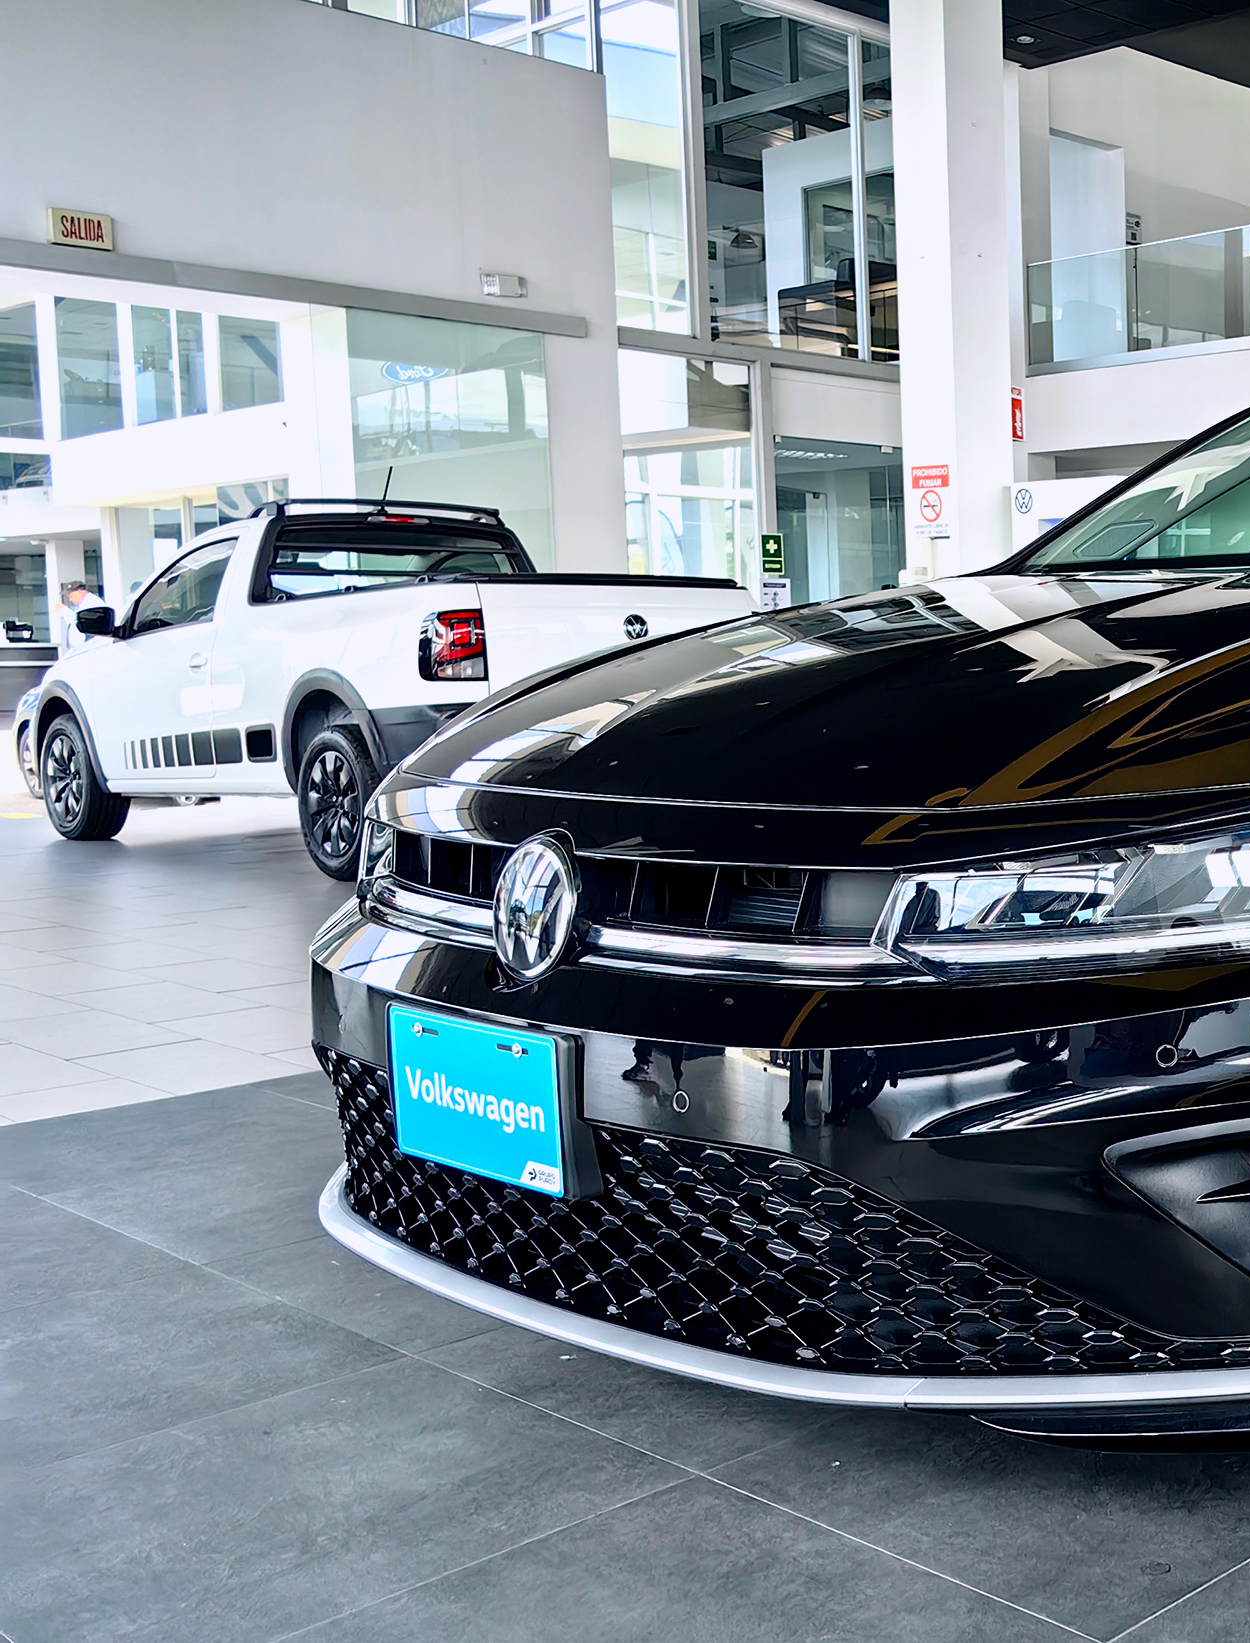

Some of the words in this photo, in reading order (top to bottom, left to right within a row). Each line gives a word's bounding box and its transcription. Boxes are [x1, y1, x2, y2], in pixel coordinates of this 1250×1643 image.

[60, 215, 105, 243] SALIDA
[913, 467, 948, 477] PROHIBIDO
[919, 478, 942, 487] FUMAR
[404, 1065, 546, 1134] Volkswagen
